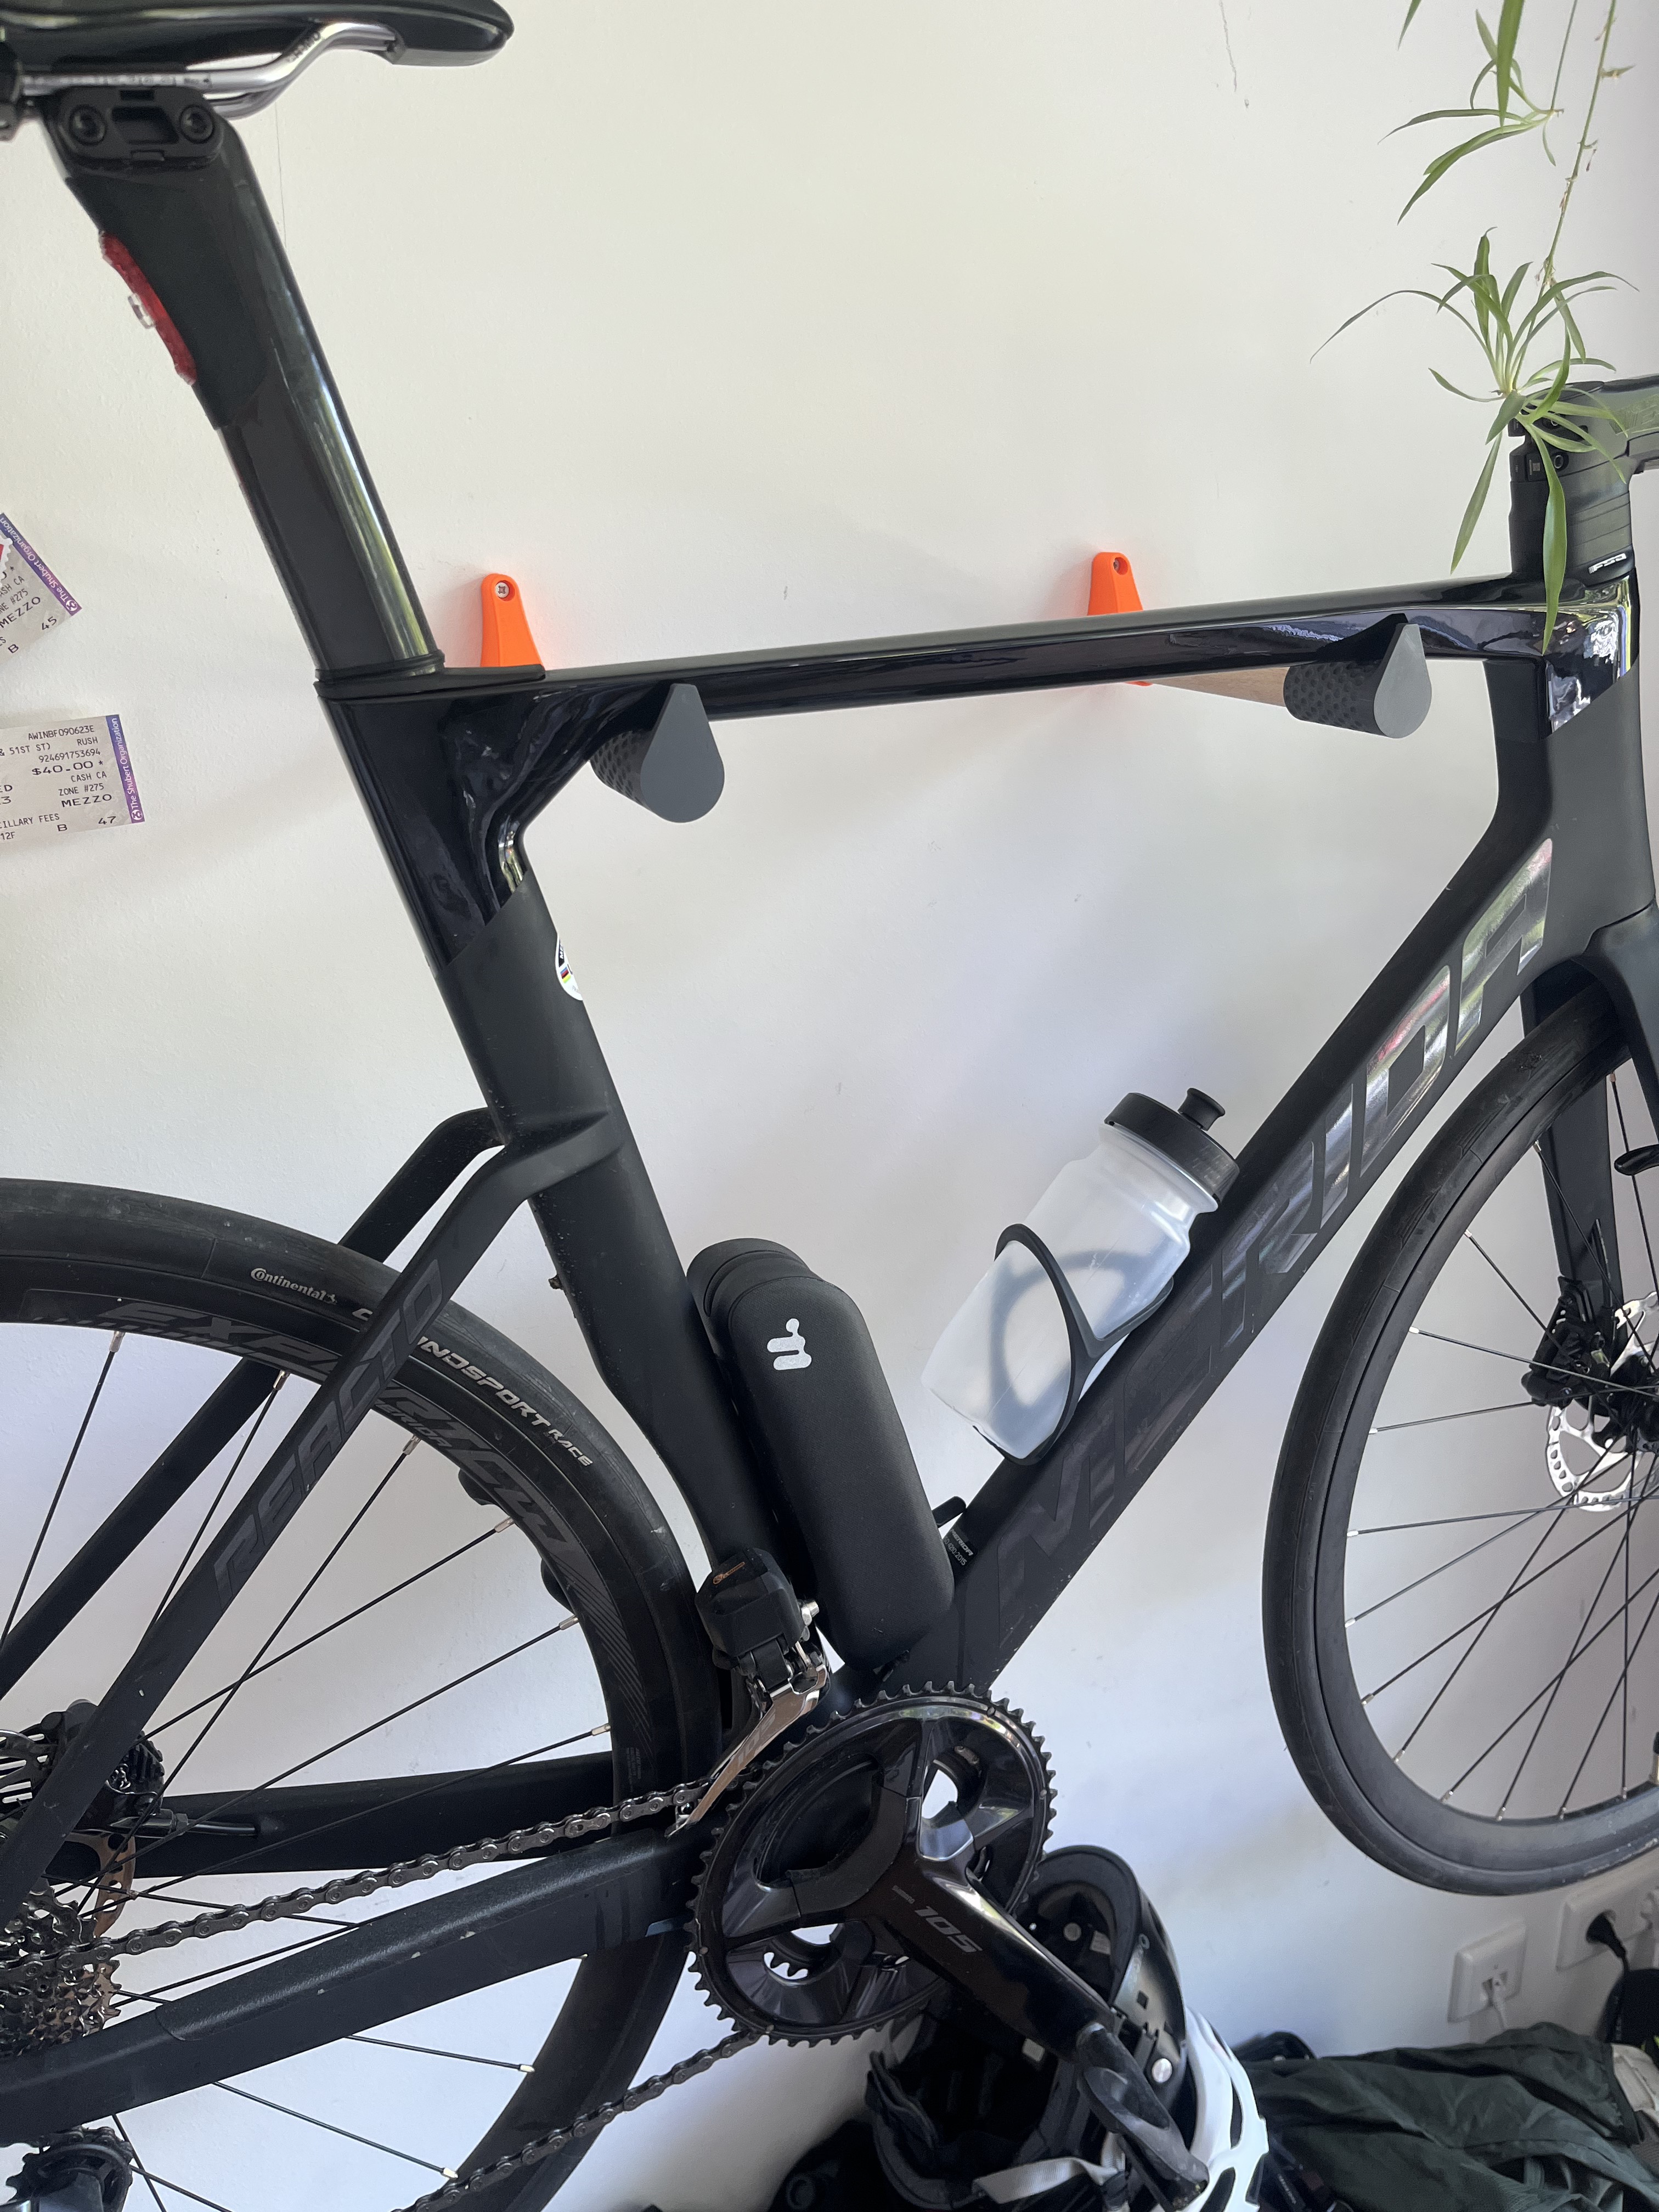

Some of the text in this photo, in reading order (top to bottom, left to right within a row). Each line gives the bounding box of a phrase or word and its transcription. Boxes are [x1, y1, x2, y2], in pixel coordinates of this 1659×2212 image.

[0, 517, 69, 602] The Shubert Organization
[14, 576, 25, 585] CA
[10, 589, 29, 604] #275
[0, 596, 41, 628] MEZZO
[42, 616, 57, 630] 45
[8, 644, 19, 653] B
[77, 736, 98, 746] RUSH
[9, 746, 30, 755] 51ST
[36, 742, 50, 751] ST)
[38, 748, 101, 763] 924691753694
[111, 718, 139, 810] The Shubert Organization
[71, 771, 107, 782] CASH CA
[58, 783, 104, 796] ZONE #275
[61, 794, 112, 808] MEZZO
[38, 813, 60, 822] FEES
[98, 816, 116, 825] 47
[57, 823, 67, 832] B
[997, 838, 1553, 1649] MERIDA
[250, 1267, 326, 1302] Continental
[213, 1259, 443, 1612] REACTO
[548, 1428, 593, 1467] RACE
[950, 1528, 974, 1556] MERIDA
[914, 1905, 984, 1953] 105
